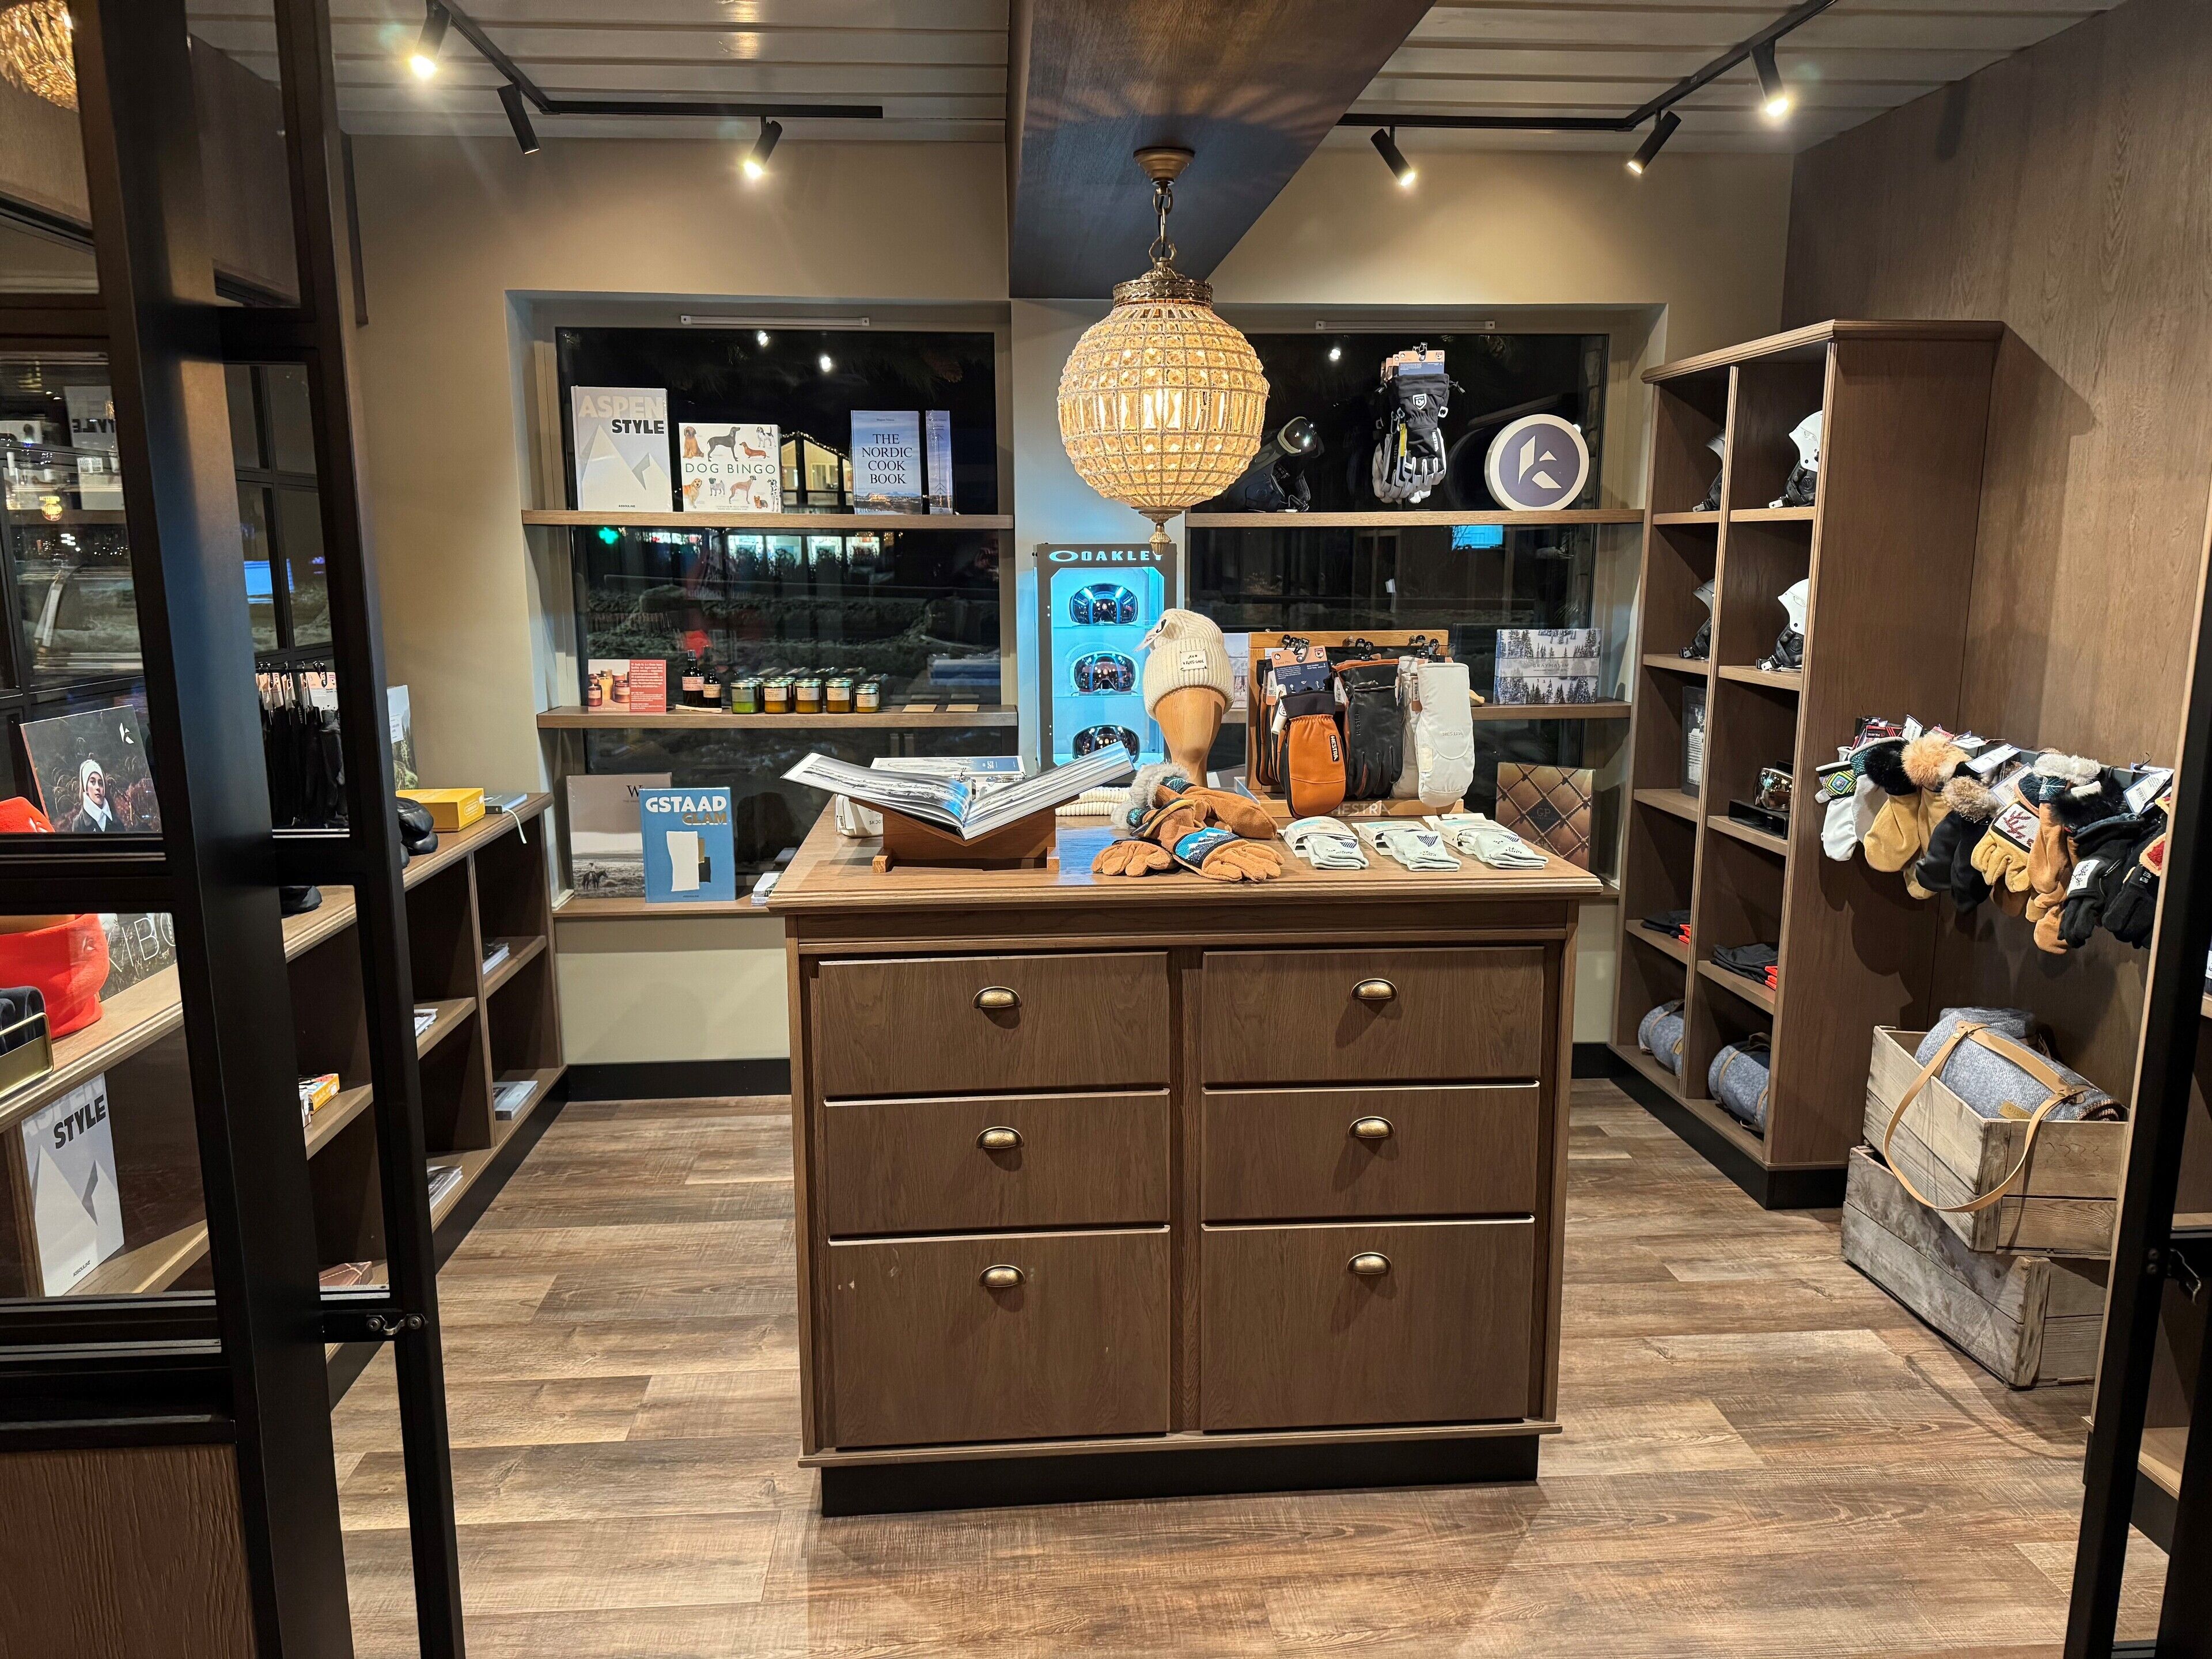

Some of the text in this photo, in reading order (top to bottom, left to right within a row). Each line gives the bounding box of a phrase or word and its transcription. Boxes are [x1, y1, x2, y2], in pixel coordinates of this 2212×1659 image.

[578, 395, 664, 419] ASPEN
[612, 419, 664, 434] STYLE
[873, 434, 900, 444] THE
[862, 447, 913, 458] NORDIC
[685, 463, 776, 474] DOG BINGO
[868, 460, 906, 471] COOK
[870, 474, 907, 484] BOOK
[1081, 551, 1163, 561] OAKLEY
[1330, 735, 1339, 761] HESTRA
[645, 796, 727, 813] GSTAAD
[1331, 802, 1391, 815] HESTRA
[682, 812, 728, 825] GLAM
[54, 1094, 106, 1149] STYLE
